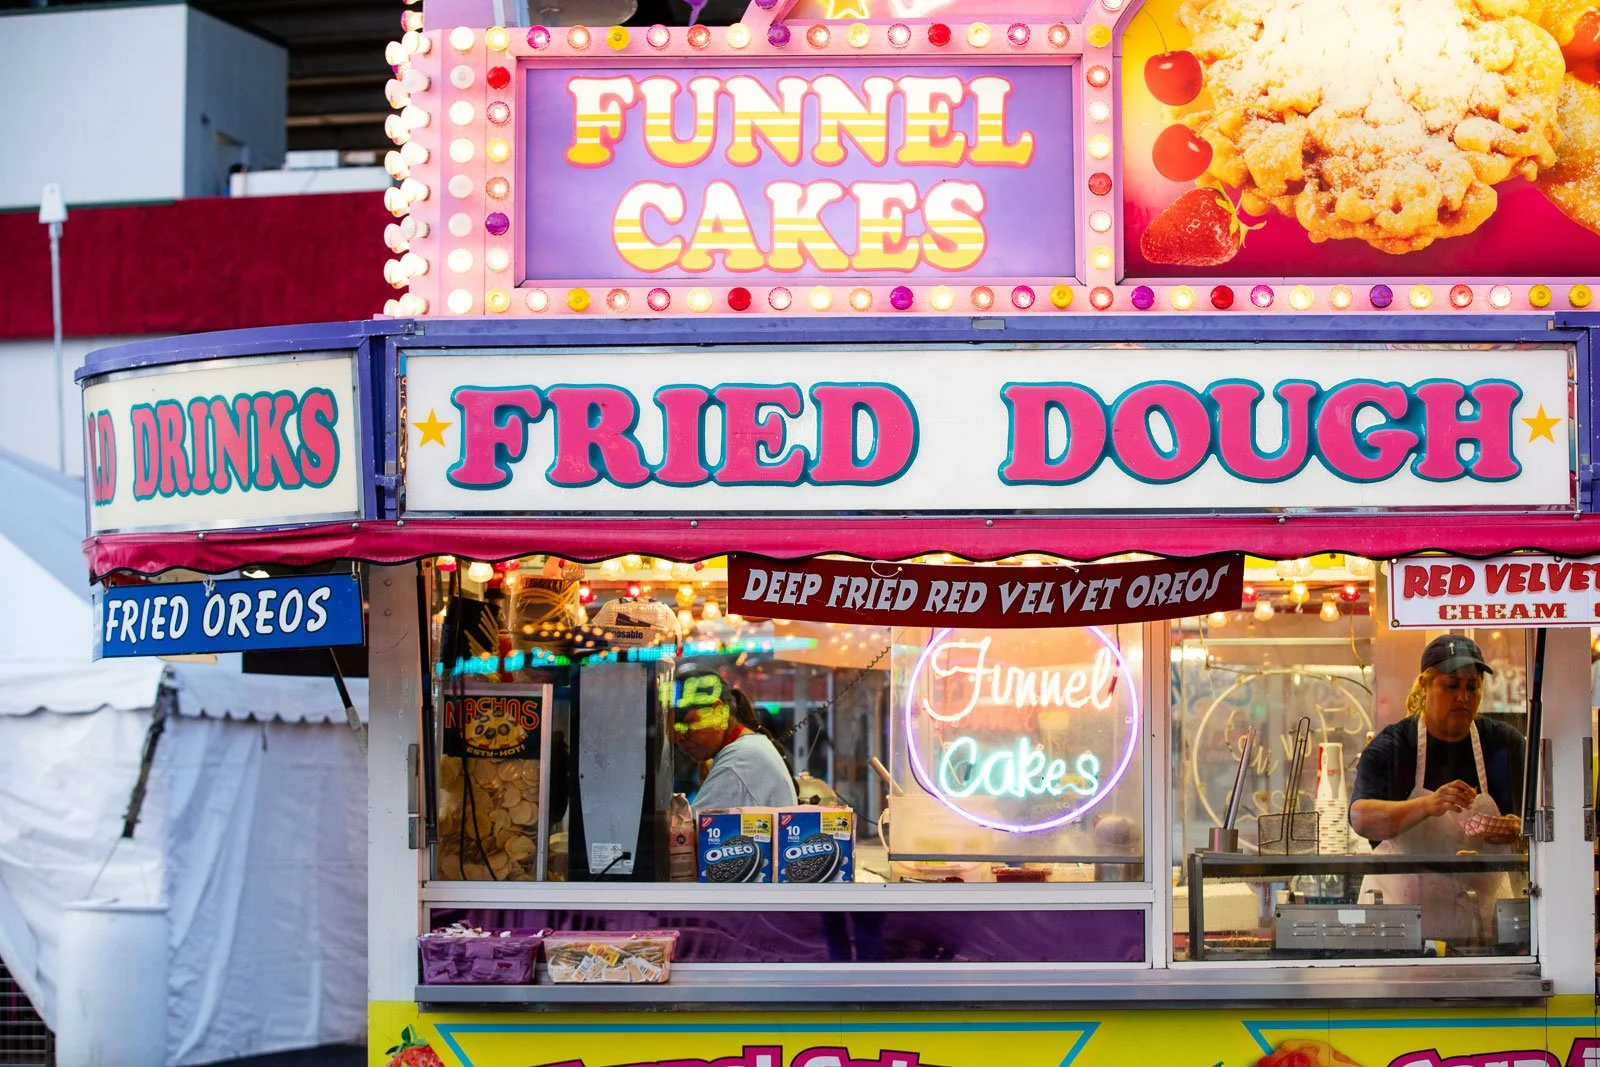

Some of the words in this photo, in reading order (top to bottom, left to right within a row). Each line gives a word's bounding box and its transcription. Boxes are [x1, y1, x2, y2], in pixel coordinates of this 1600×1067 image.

[565, 75, 1035, 168] FUNNEL
[612, 180, 988, 272] CAKES
[131, 387, 340, 502] DRINKS
[446, 381, 920, 490] FRIED
[998, 378, 1523, 486] DOUGH
[742, 569, 822, 606] DEEP
[826, 576, 918, 611] FRIED
[924, 580, 988, 614] RED
[998, 578, 1123, 615] VELVET
[1125, 564, 1230, 609] OREOS
[1403, 564, 1475, 599] RED
[105, 596, 189, 643] FRIED
[202, 587, 332, 638] OREOS
[1438, 603, 1568, 620] CREAM
[922, 636, 1113, 722] Funnel
[444, 697, 539, 731] NACHOS
[939, 737, 1100, 798] Cakes
[706, 828, 721, 838] 10
[706, 845, 753, 861] OREO
[785, 843, 832, 859] OREO
[786, 826, 800, 836] 10
